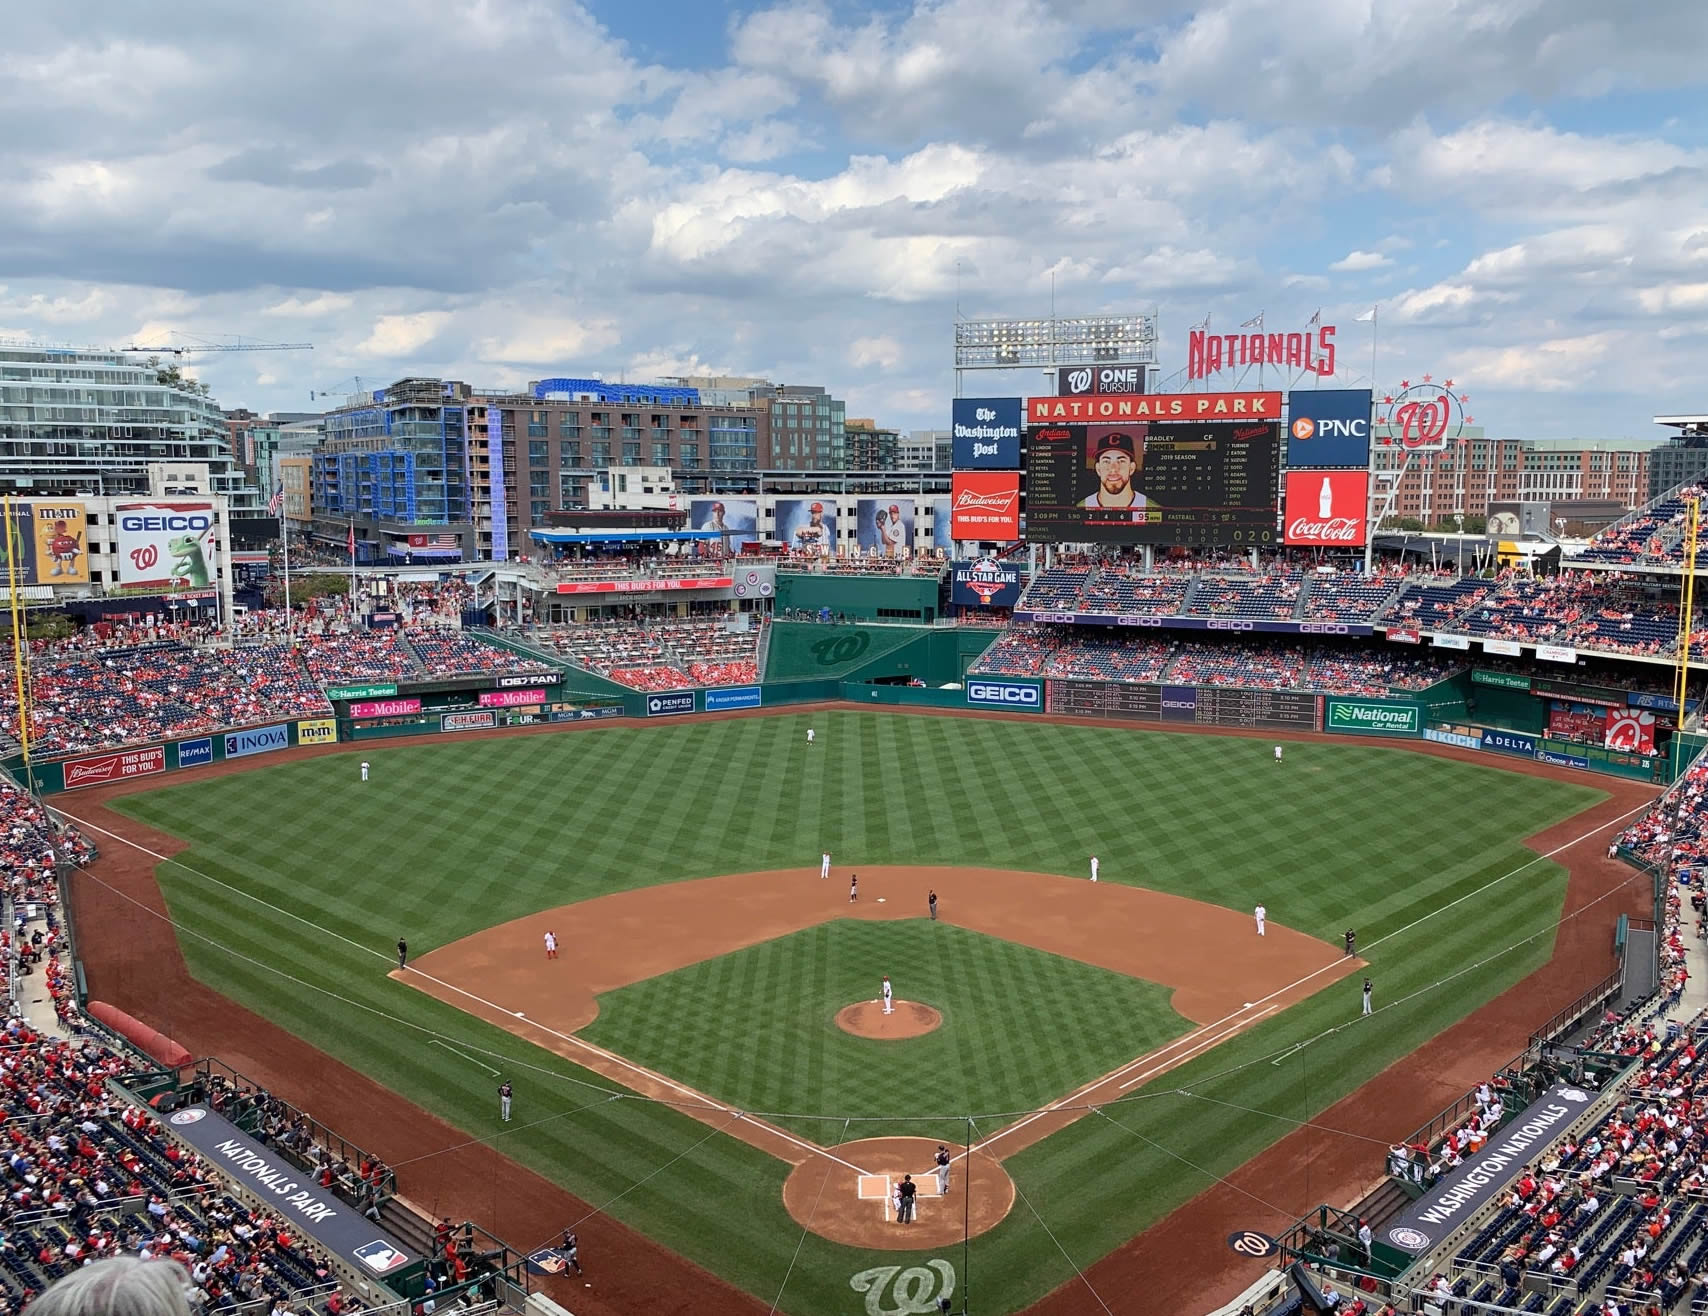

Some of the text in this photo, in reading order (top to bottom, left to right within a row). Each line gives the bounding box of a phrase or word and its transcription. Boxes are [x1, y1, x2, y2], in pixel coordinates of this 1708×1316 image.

[1188, 326, 1336, 380] NATIONALS
[1100, 369, 1138, 382] ONE
[1100, 382, 1137, 392] PURSUIT
[1036, 398, 1266, 417] NATIONALS PARK
[976, 408, 996, 422] The
[955, 423, 1018, 440] Washington
[1318, 419, 1366, 436] PNC
[973, 442, 998, 458] Post
[958, 493, 1010, 506] Budweiser
[122, 515, 209, 532] GEICO
[1288, 518, 1360, 541] Coca-Cola
[972, 572, 993, 582] STAR
[995, 573, 1016, 583] GAME
[615, 582, 630, 590] THIS
[631, 581, 651, 590] BUD'S
[653, 581, 665, 589] FOR
[1032, 613, 1075, 624] GEICO
[1118, 616, 1161, 627] GEICO
[1207, 620, 1253, 631] GEICO
[1299, 623, 1348, 634] GEICO
[531, 675, 557, 684] FAN
[1482, 674, 1504, 685] Harris
[1506, 678, 1529, 688] Teeter
[340, 687, 395, 698] Harris Teeter
[970, 686, 1037, 702] GEICO
[1163, 701, 1195, 709] GEICO
[1352, 707, 1411, 723] National
[242, 732, 286, 750] INOVA
[1438, 732, 1476, 748] KOCH
[1496, 736, 1532, 751] DELTA
[122, 751, 162, 765] THIS BUD'S
[180, 746, 210, 758] RE/MAX
[71, 766, 112, 778] Budweiser
[122, 762, 156, 774] FOR YOU.
[1418, 1104, 1568, 1224] WASHINGTON NATIONALS
[214, 1138, 337, 1223] NATIONALS PARK
